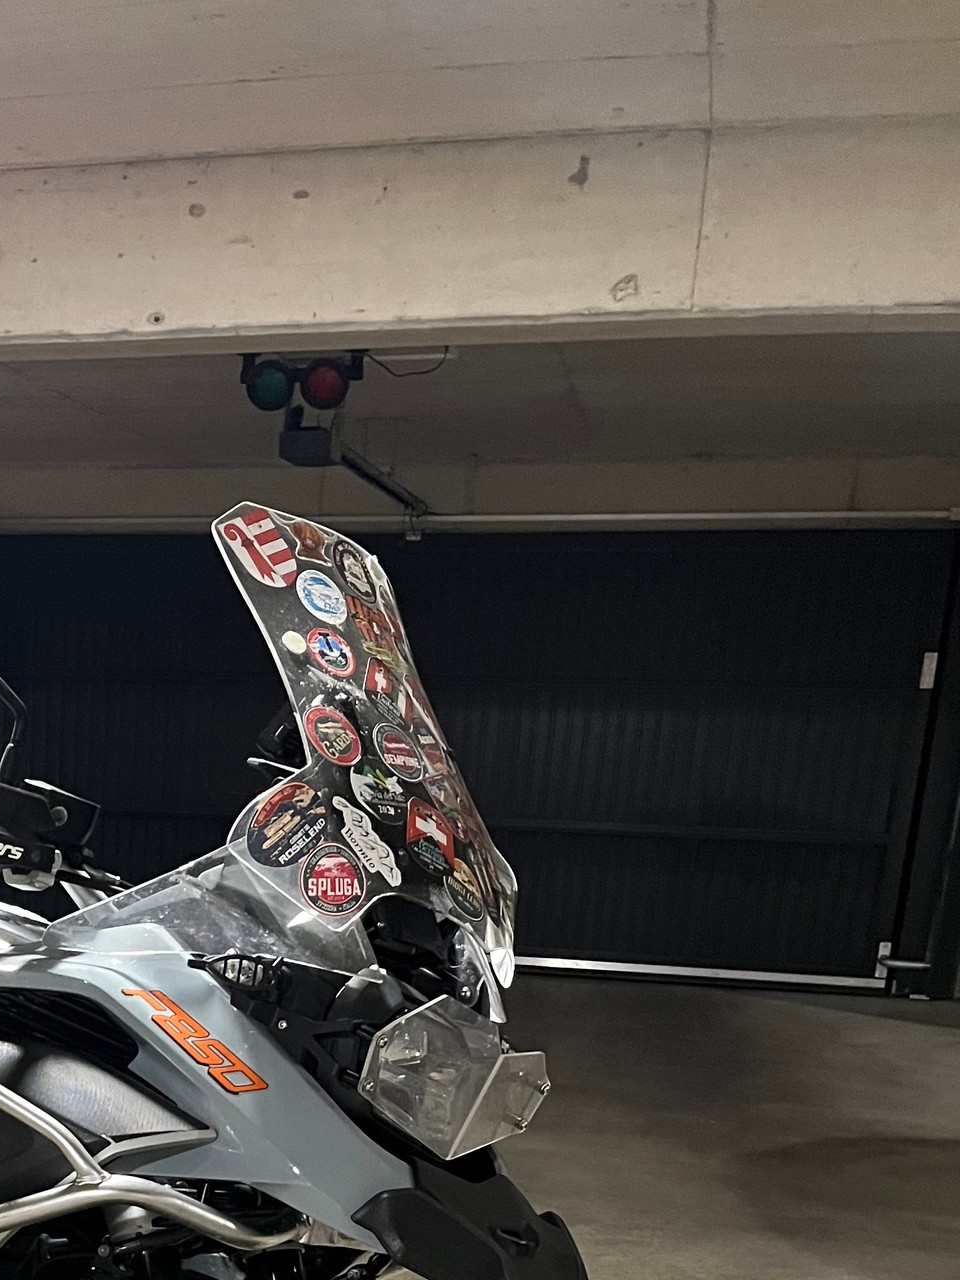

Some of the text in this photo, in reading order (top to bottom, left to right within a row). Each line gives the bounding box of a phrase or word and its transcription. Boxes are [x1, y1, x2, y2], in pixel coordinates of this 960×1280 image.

[322, 730, 356, 759] GARDA
[278, 818, 326, 865] ROSELEND
[344, 827, 376, 870] Bormio
[308, 877, 362, 897] SPLUGA
